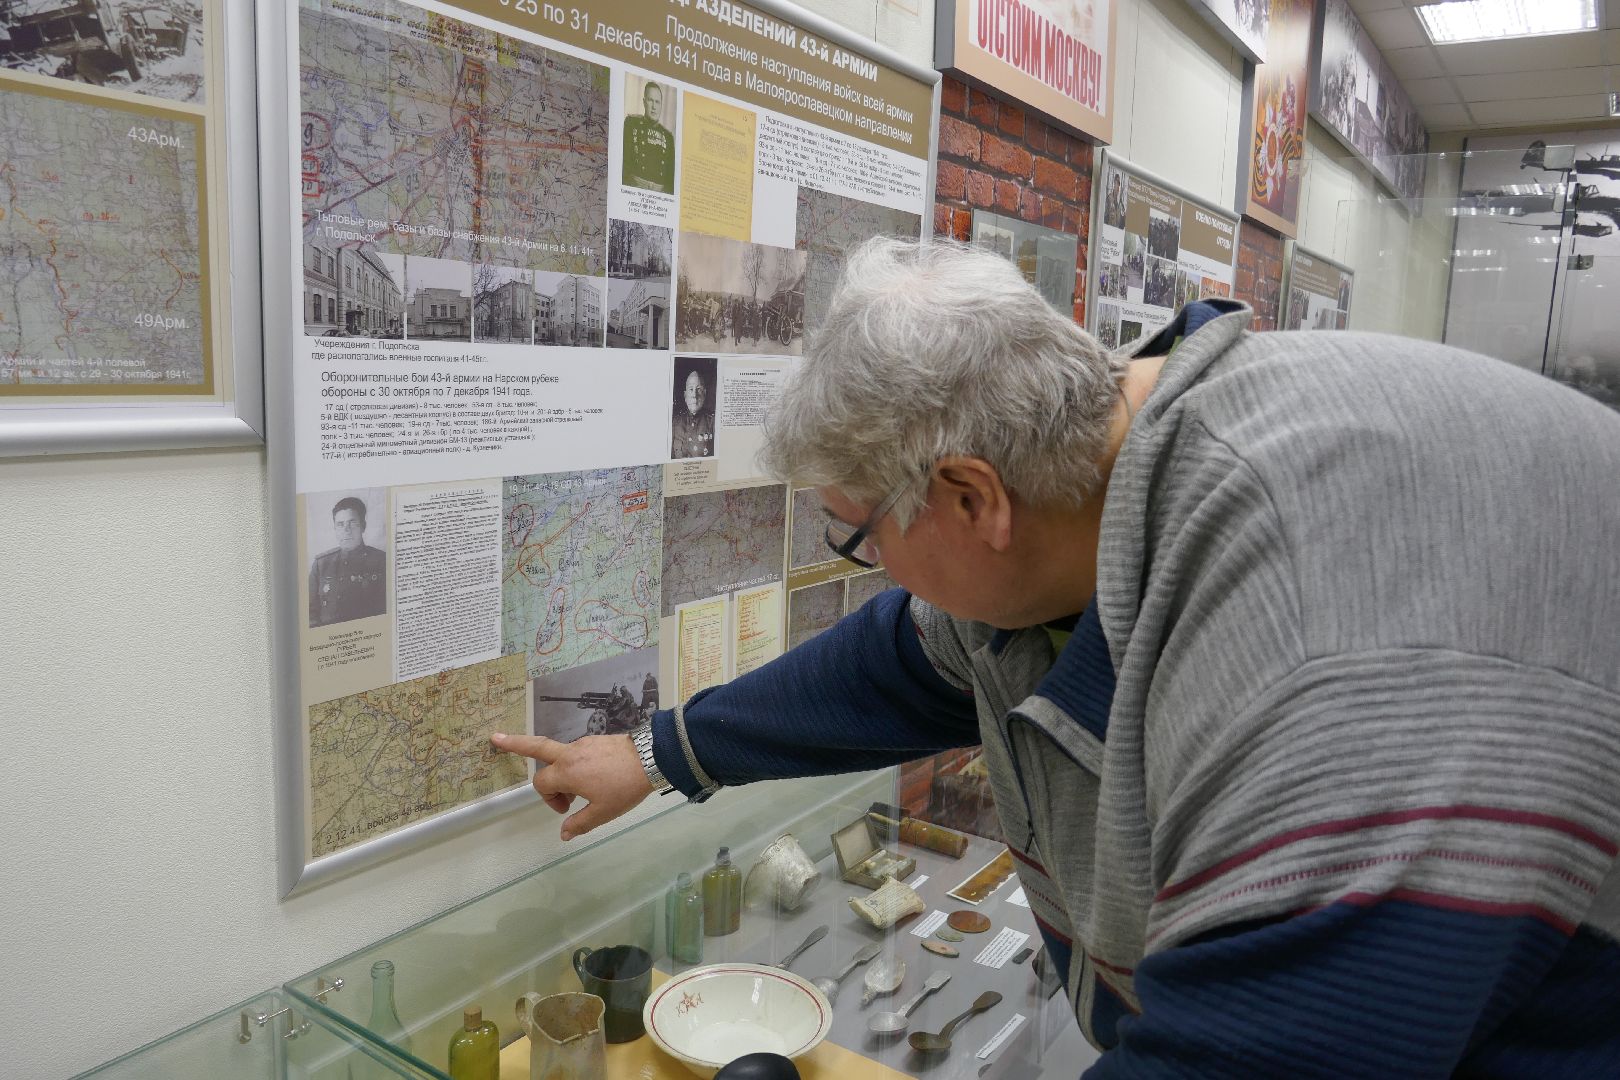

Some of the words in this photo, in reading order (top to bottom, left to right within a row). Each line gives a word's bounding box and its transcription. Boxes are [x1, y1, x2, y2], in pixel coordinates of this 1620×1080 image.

[799, 36, 829, 62] 43-й
[832, 50, 879, 82] АРМИИ
[977, 0, 1042, 81] ОТСТОИМ
[1044, 18, 1102, 113] МОСКВУ!
[515, 0, 539, 16] 25
[543, 4, 565, 25] по
[570, 8, 590, 34] 31
[594, 22, 661, 58] декабря
[665, 43, 698, 71] 1941
[702, 59, 732, 83] года
[734, 71, 742, 86] в
[745, 70, 853, 125] Малоярославецком
[855, 115, 913, 146] направлении
[666, 15, 758, 66] Продолжение
[761, 53, 831, 94] наступления
[833, 82, 861, 105] войск
[863, 94, 885, 114] всей
[886, 105, 913, 125] армии
[128, 126, 185, 150] 43Арм.
[315, 209, 365, 227] Тыловые
[393, 220, 417, 233] базы
[427, 225, 451, 238] базы
[453, 230, 500, 245] снабжения
[501, 236, 520, 248] 43-й
[521, 238, 548, 251] Армии
[549, 243, 559, 252] на
[325, 226, 379, 243] Подольск.
[134, 313, 190, 331] 49Арм.
[378, 341, 420, 351] Подольска
[49, 358, 85, 367] частей
[86, 357, 103, 367] 4-й
[105, 358, 147, 368] полевой
[311, 352, 325, 361] где
[327, 352, 388, 362] располагались
[389, 353, 422, 362] военные
[125, 370, 164, 381] октября
[321, 371, 409, 384] Оборонительные
[411, 372, 429, 383] бои
[430, 372, 451, 383] 43-й
[452, 374, 481, 385] армии
[482, 374, 493, 383] на
[495, 373, 530, 384] Нарском
[321, 386, 367, 399] обороны
[369, 388, 376, 397] с
[378, 386, 390, 397] 30
[392, 386, 430, 399] октября
[432, 387, 444, 397] по
[446, 386, 452, 396] 7
[453, 386, 490, 398] декабря
[491, 386, 511, 396] 1941
[324, 403, 333, 411] 17
[320, 422, 337, 431] 93-я
[343, 432, 348, 440] 3
